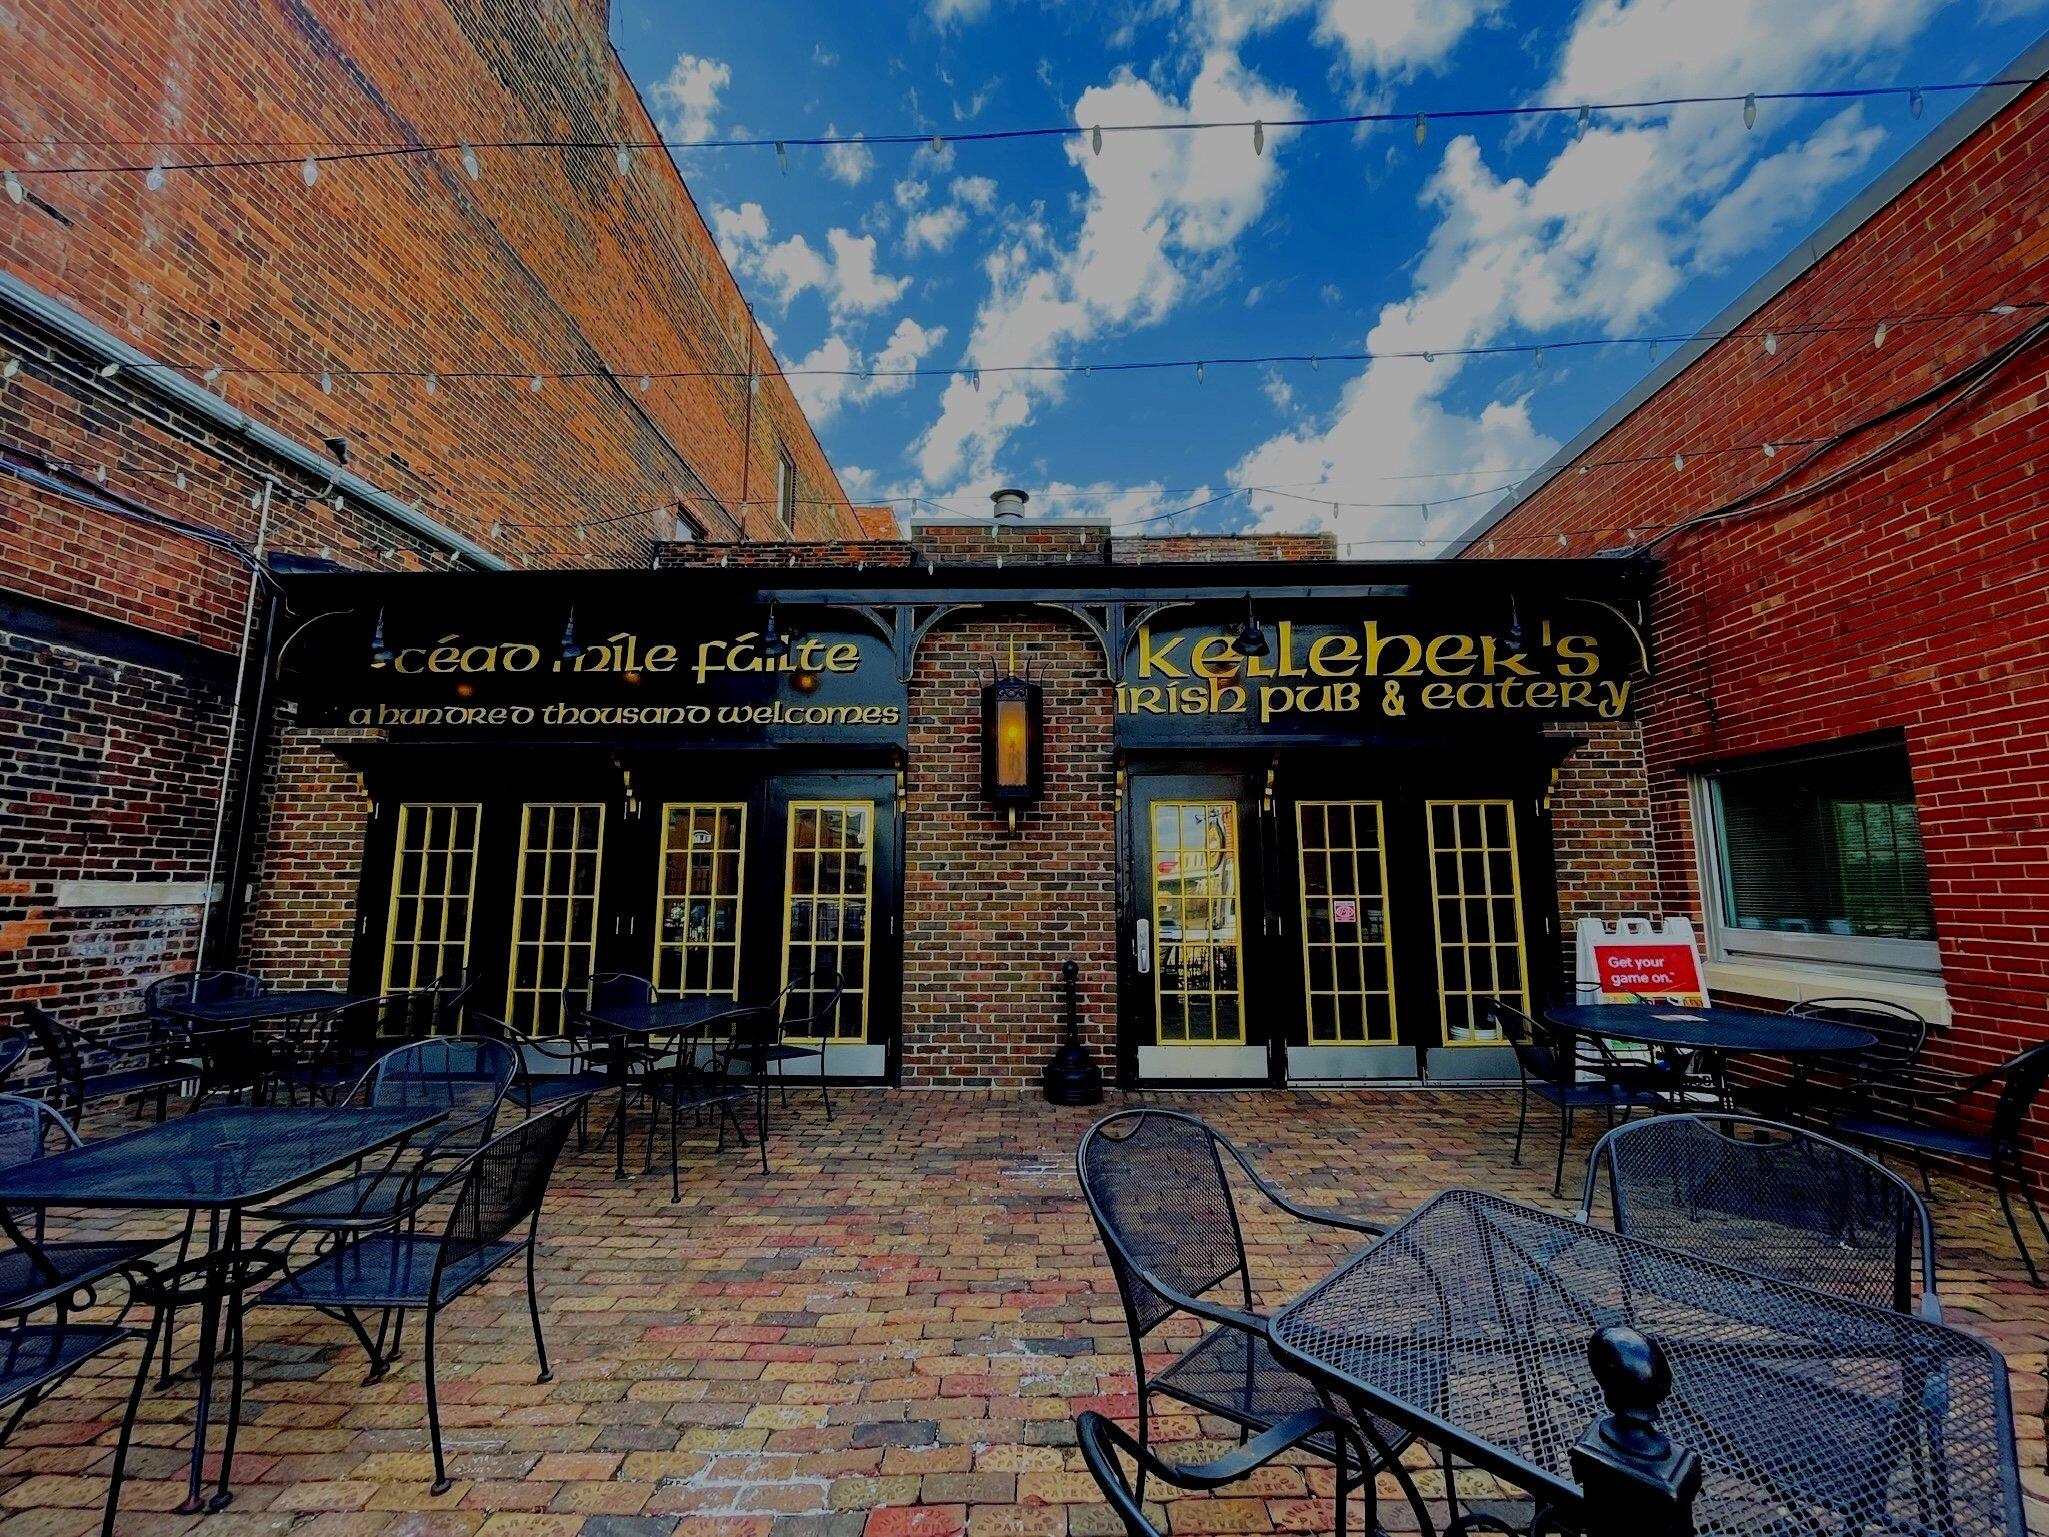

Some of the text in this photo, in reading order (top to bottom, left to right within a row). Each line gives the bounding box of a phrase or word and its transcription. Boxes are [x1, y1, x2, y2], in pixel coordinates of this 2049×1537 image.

[1381, 680, 1406, 717] &
[349, 707, 371, 725] a
[542, 702, 711, 725] thousand
[717, 701, 900, 725] welcomes
[1608, 957, 1664, 970] Get your
[1611, 973, 1649, 986] game
